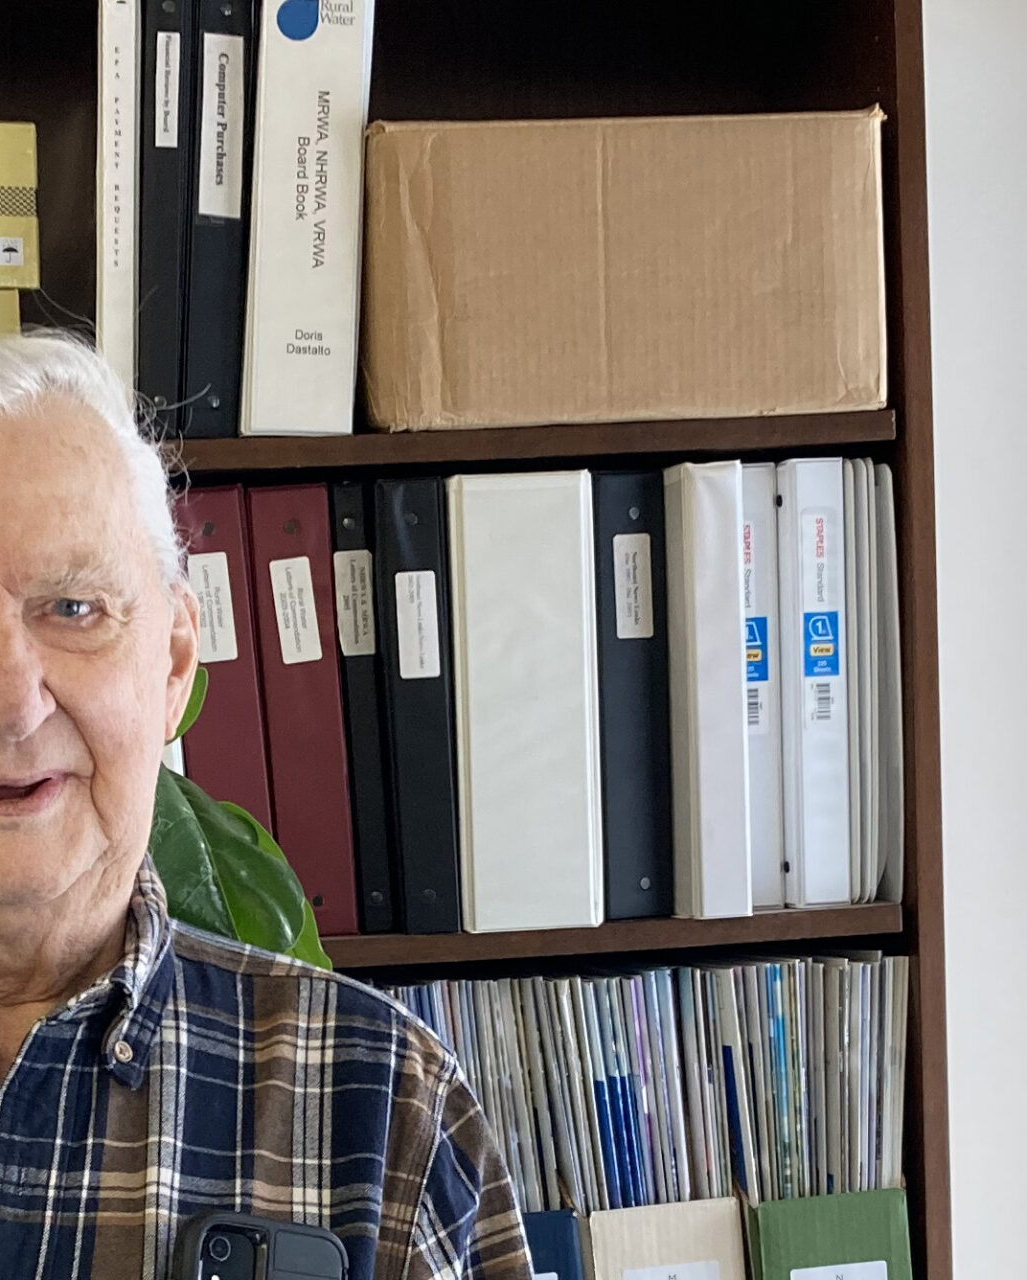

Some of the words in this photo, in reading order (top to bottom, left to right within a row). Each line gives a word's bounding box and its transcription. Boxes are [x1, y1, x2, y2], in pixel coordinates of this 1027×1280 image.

[320, 11, 356, 26] Water
[216, 52, 230, 119] Computer
[113, 97, 122, 169] PAYMENT
[162, 110, 170, 133] Board
[215, 121, 227, 187] Purchases
[296, 136, 310, 180] Board
[313, 150, 329, 215] NHRWA,
[294, 184, 309, 221] Book
[113, 184, 121, 268] REQUESTS
[311, 219, 326, 269] VRWA
[294, 329, 323, 342] Doris
[815, 517, 825, 559] STAPLES
[202, 564, 210, 590] Letters
[285, 566, 293, 592] Letters
[816, 561, 825, 603] Standard
[297, 587, 305, 607] Rural
[300, 607, 308, 630] Water
[813, 646, 832, 654] View
